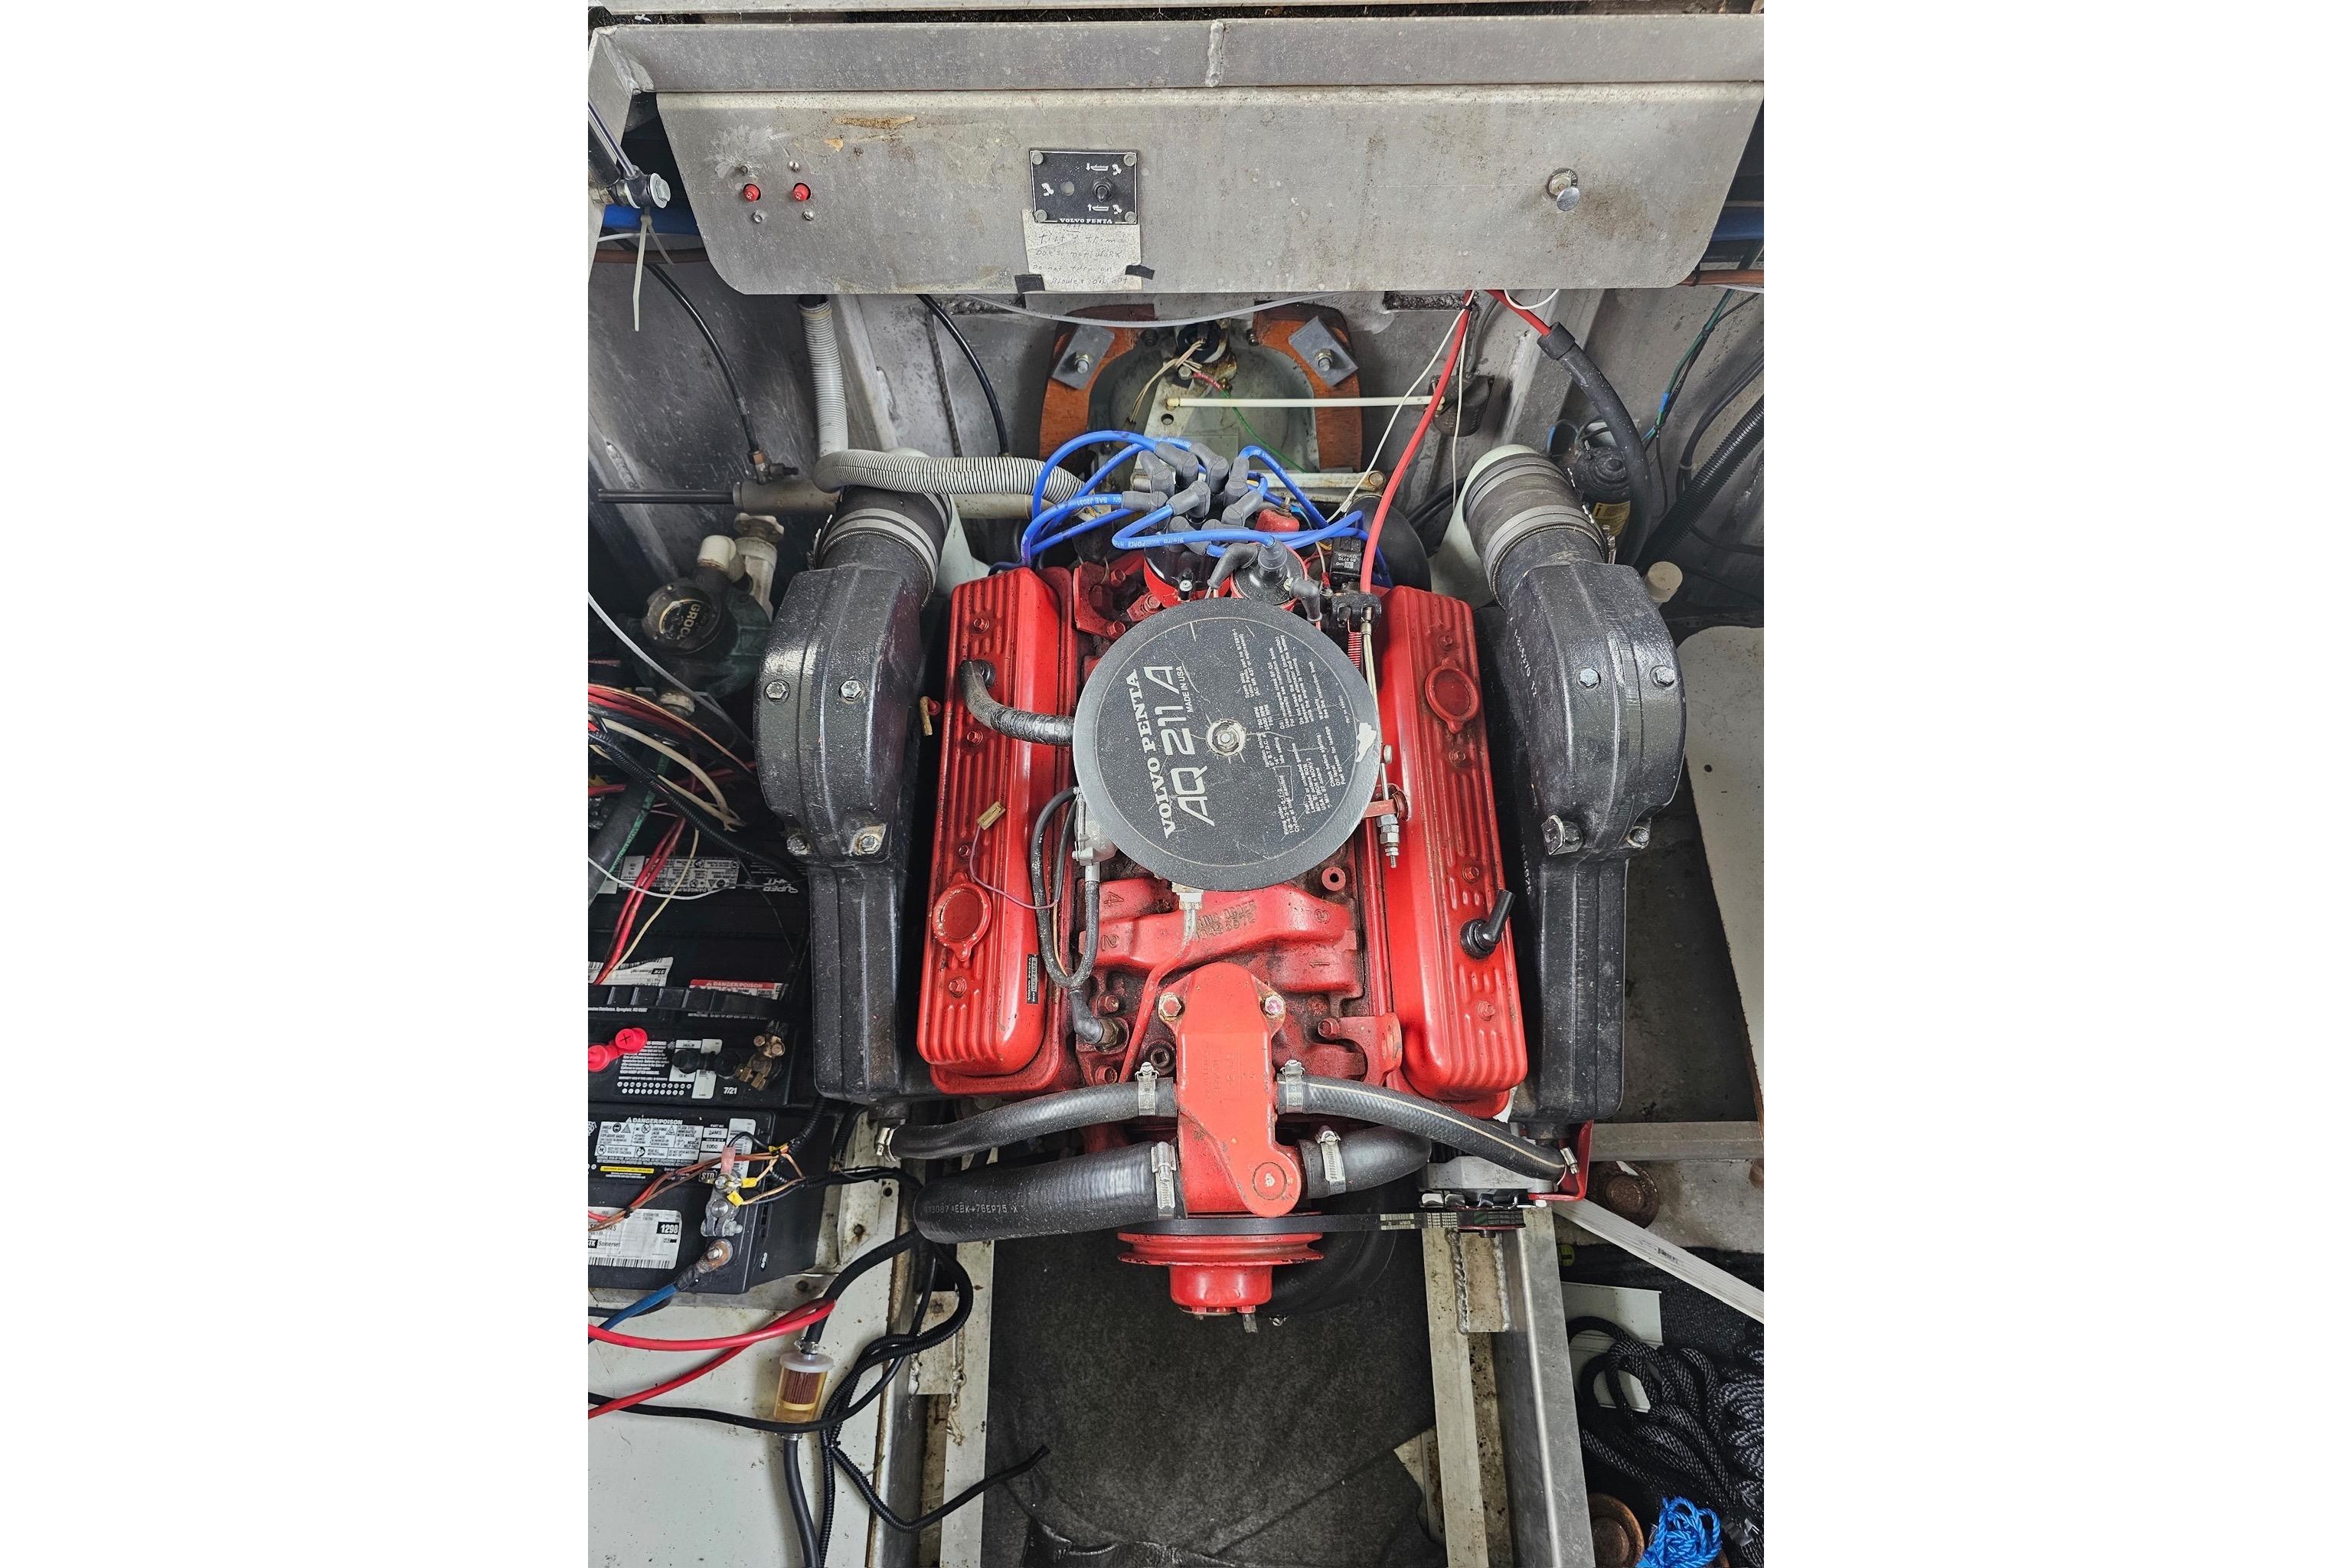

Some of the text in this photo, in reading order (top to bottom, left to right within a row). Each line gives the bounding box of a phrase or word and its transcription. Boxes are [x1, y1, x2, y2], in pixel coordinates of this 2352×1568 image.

[1274, 636, 1283, 653] switch)
[1279, 634, 1288, 650] battery
[1279, 654, 1287, 667] (main
[1292, 657, 1301, 676] running
[1238, 670, 1250, 698] Spark plug:
[1283, 668, 1291, 683] circuit
[1175, 665, 1194, 712] MADE IN USA
[1299, 682, 1308, 698] engine
[1312, 674, 1323, 698] instruction
[1276, 691, 1287, 716] multigrade
[1282, 695, 1293, 717] viscosity
[1299, 703, 1309, 723] between
[1313, 696, 1324, 719] Warranty:
[1262, 717, 1270, 730] 2500
[1324, 726, 1334, 745] leakage
[1123, 669, 1178, 837] VOLVO PENTA
[1143, 666, 1215, 826] AQ 211 A
[1291, 742, 1301, 762] gasoline
[1315, 732, 1335, 787] Check before starting:
[1333, 754, 1342, 772] system
[1297, 763, 1307, 786] unleaded
[1315, 767, 1323, 784] octane
[1306, 776, 1315, 793] octane
[1306, 794, 1315, 812] Leaded
[661, 1224, 678, 1234] 1298
